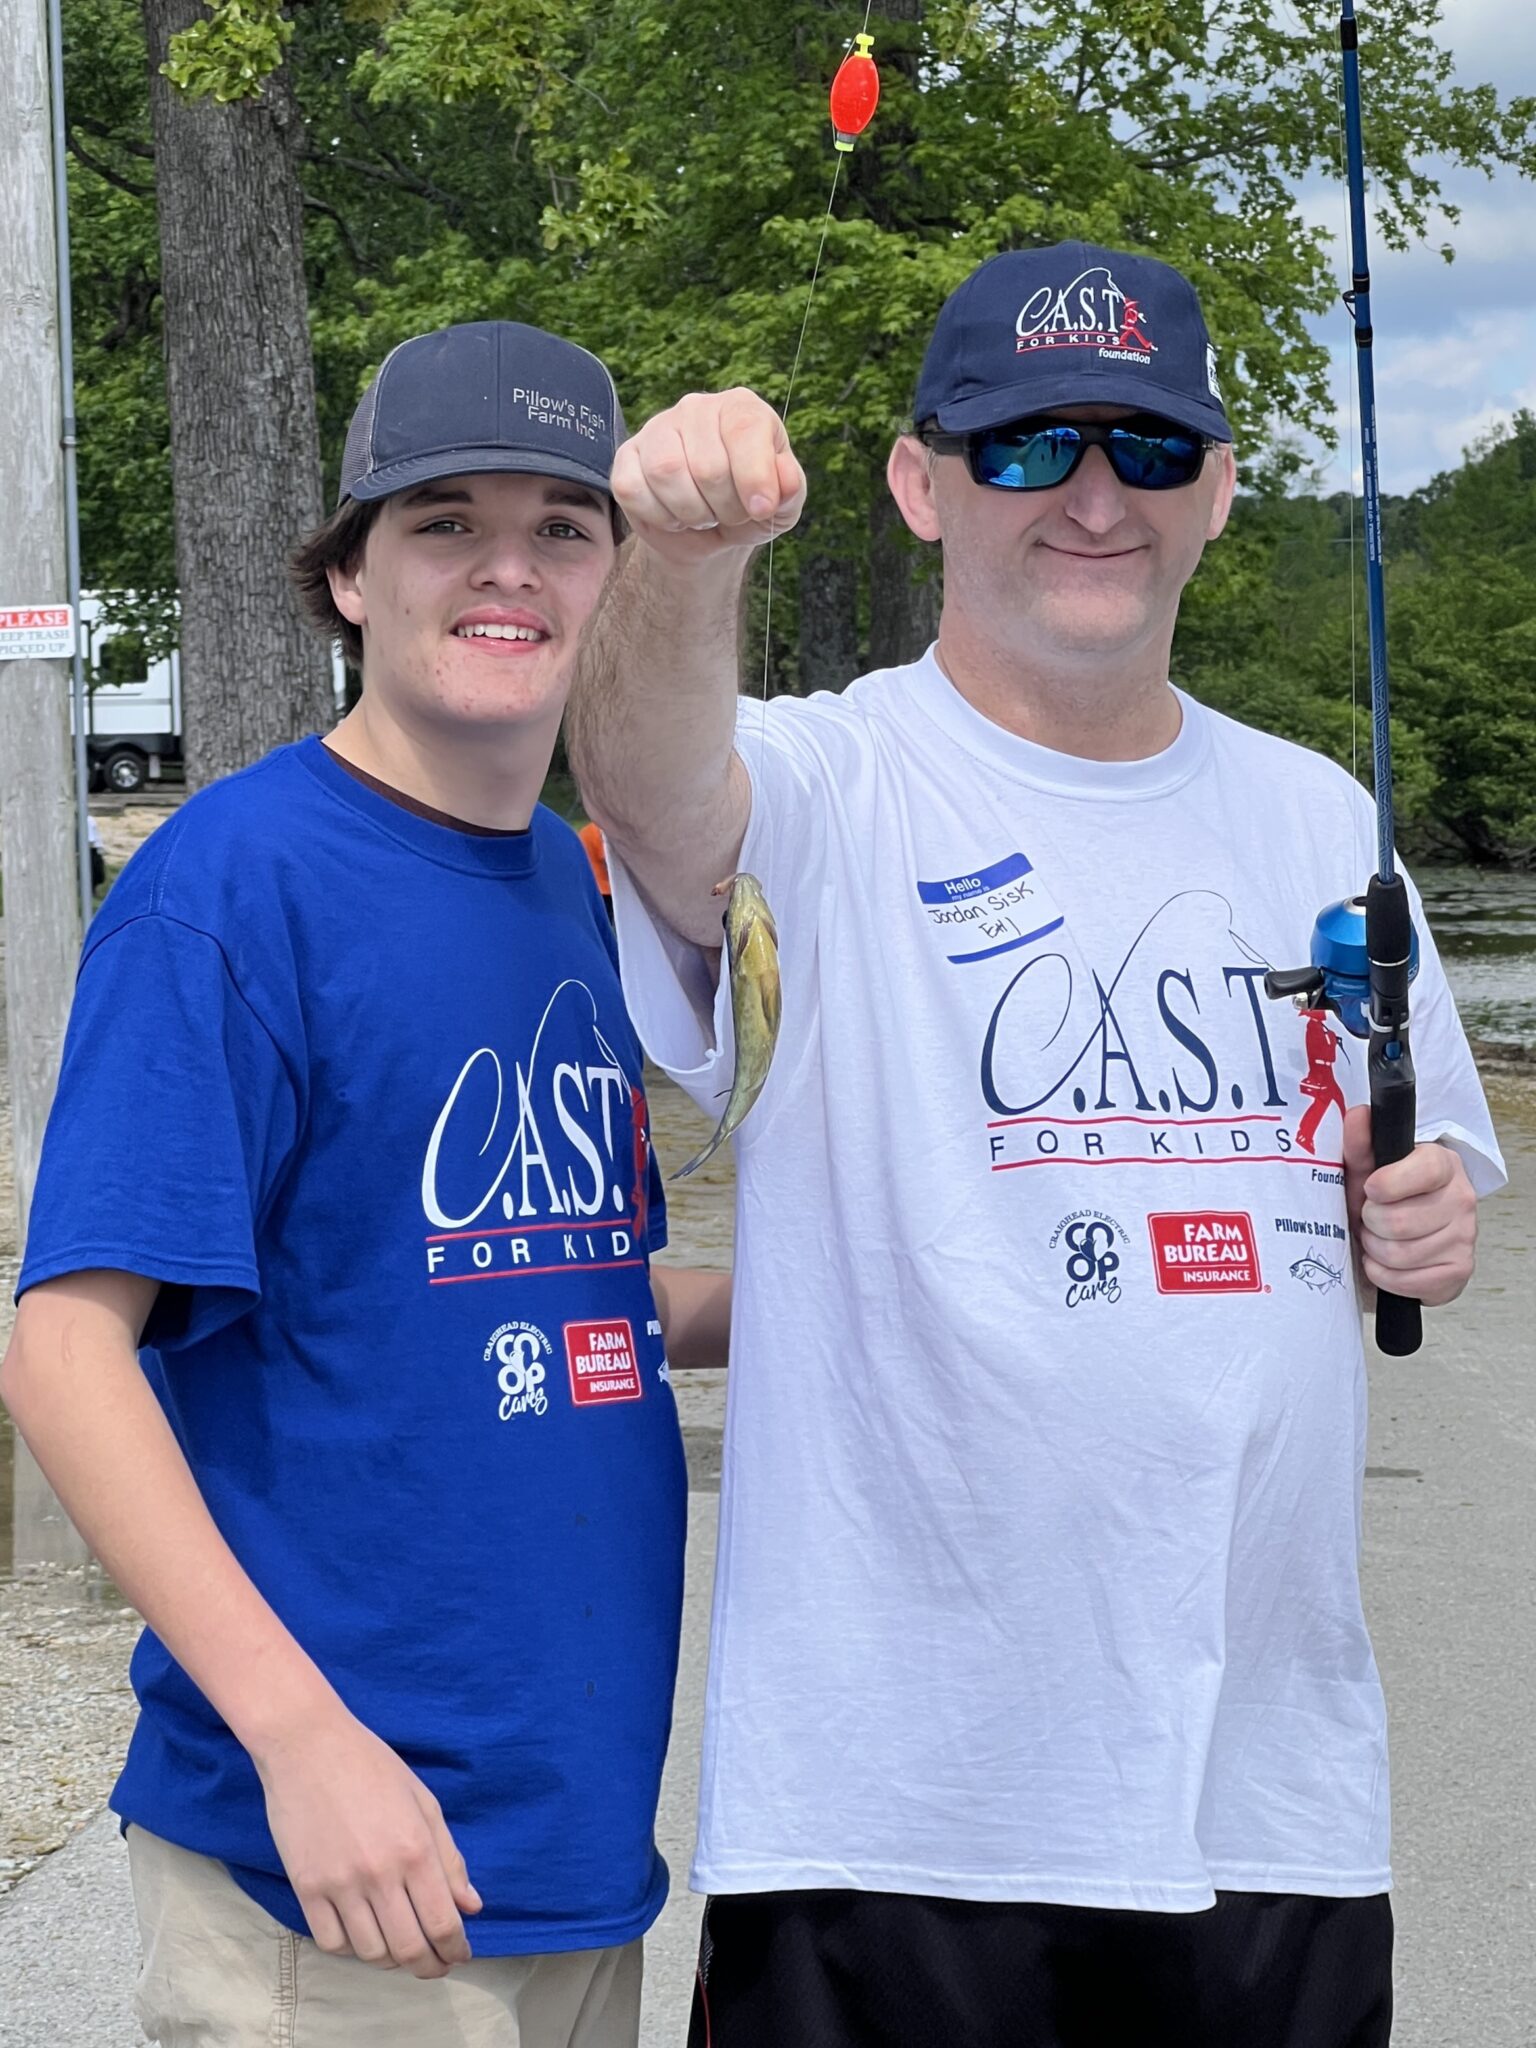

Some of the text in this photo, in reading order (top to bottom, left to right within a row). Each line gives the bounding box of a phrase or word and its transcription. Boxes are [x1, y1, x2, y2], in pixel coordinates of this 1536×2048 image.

[1017, 334, 1120, 350] FOR KIDS
[1098, 347, 1151, 365] foundation
[513, 388, 606, 431] Pillow's Fish
[528, 406, 599, 442] Farm Inc.
[49, 643, 66, 653] UP
[944, 878, 981, 895] Hello
[928, 905, 988, 924] Jordan
[989, 1128, 1292, 1162] FOR KIDS
[1049, 1209, 1131, 1249] CRAIGHEAD ELECTRIC
[1183, 1222, 1243, 1243] FARM
[427, 1230, 630, 1273] FOR KID
[1163, 1243, 1248, 1263] BUREAU
[1183, 1269, 1251, 1283] INSURANCE
[1065, 1276, 1122, 1308] Cares
[588, 1332, 627, 1352] FARM
[575, 1352, 632, 1374] BUREAU
[590, 1378, 635, 1393] INSURANCE
[498, 1386, 548, 1421] Cares
